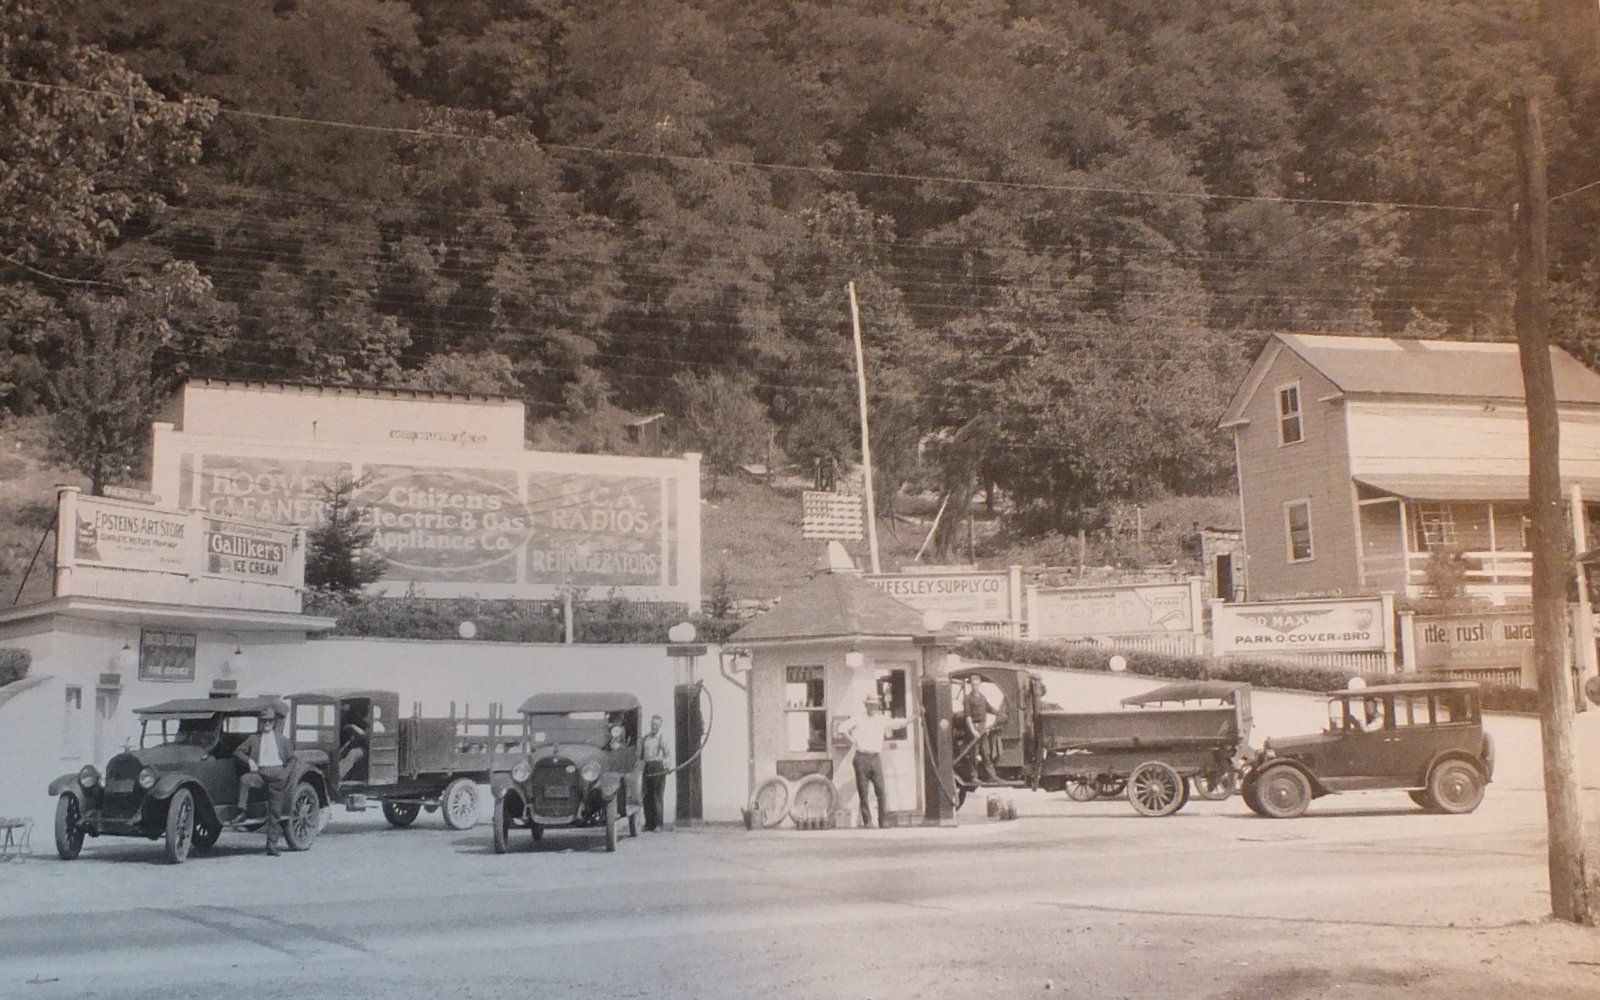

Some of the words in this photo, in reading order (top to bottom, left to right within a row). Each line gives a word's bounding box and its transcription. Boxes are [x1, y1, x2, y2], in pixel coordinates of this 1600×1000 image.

[389, 487, 502, 510] Citizen's
[141, 517, 158, 535] ART
[160, 520, 184, 539] STORE
[461, 511, 477, 531] &
[482, 512, 526, 532] Gas
[551, 509, 649, 533] RADIOS
[371, 528, 477, 552] Appliance
[234, 560, 246, 573] ICE
[249, 561, 278, 576] CREAM
[533, 550, 657, 575] REFRIGERATORS
[937, 578, 981, 594] SUPPLY
[982, 578, 1000, 593] CO
[1235, 634, 1273, 645] PARK
[1288, 632, 1336, 643] COVER
[1343, 631, 1371, 642] BRO
